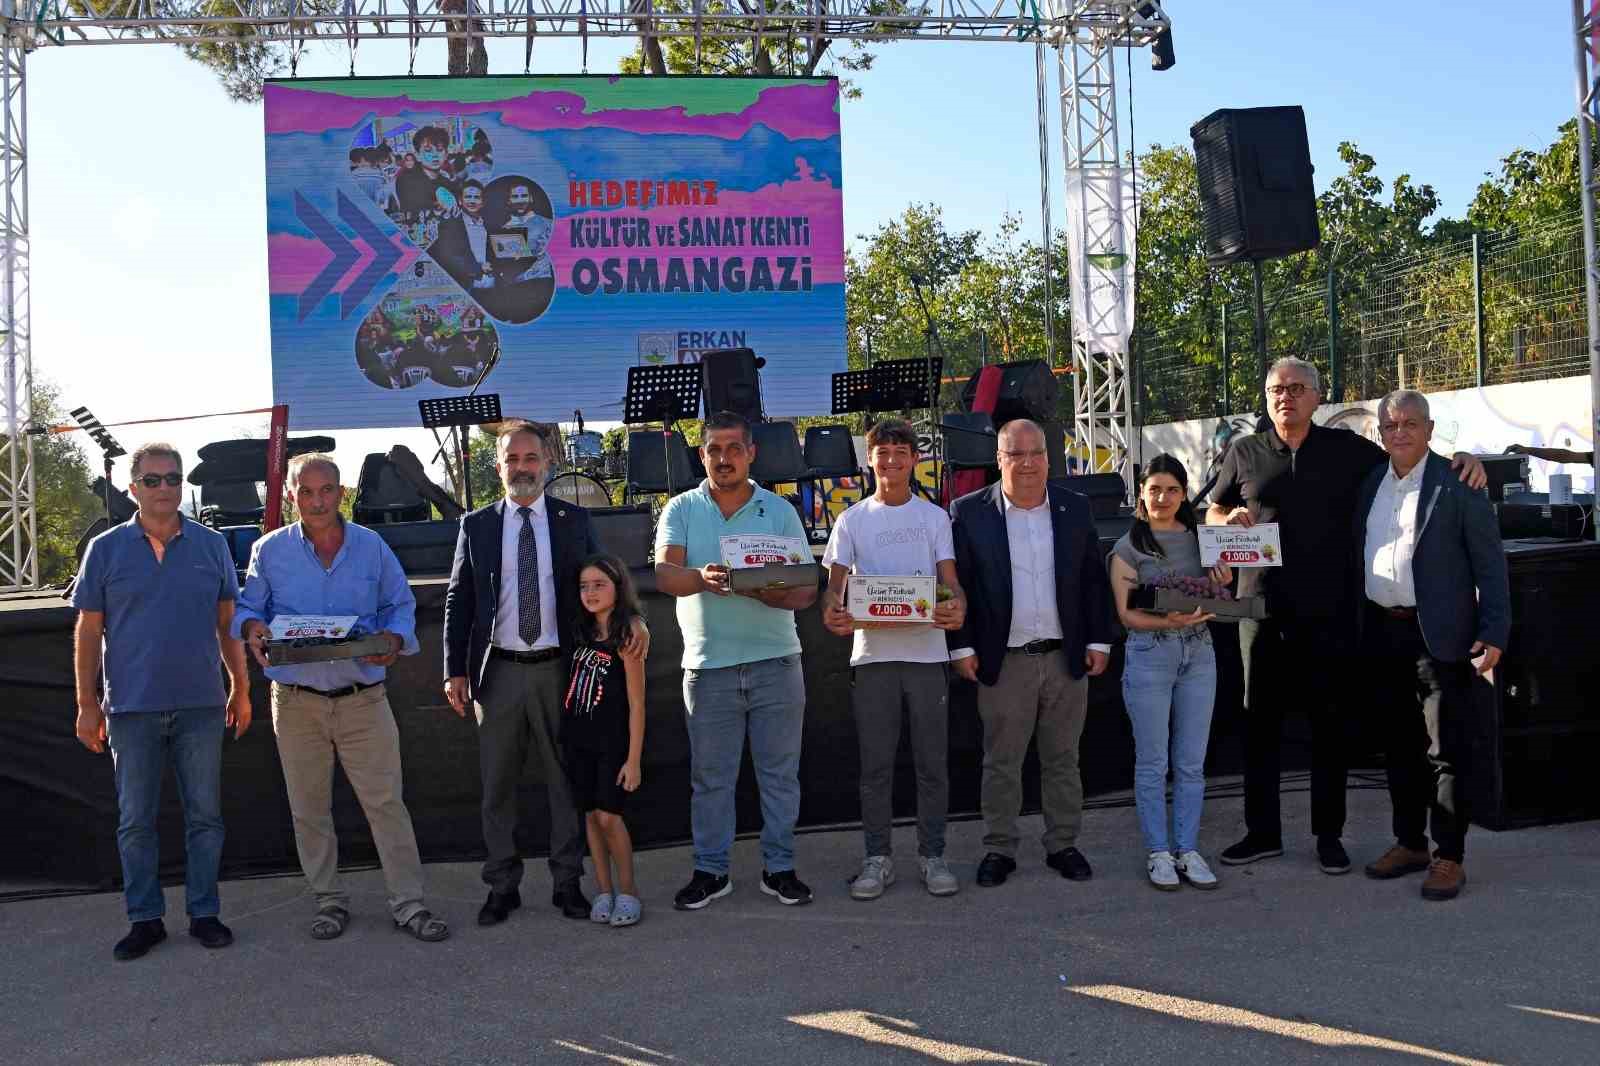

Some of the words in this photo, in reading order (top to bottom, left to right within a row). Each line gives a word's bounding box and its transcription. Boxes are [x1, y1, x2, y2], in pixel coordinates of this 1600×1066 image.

[570, 217, 650, 248] KÜLTÜR
[679, 216, 746, 247] SANAT
[678, 331, 746, 348] ERKAN
[875, 604, 903, 615] 7.000
